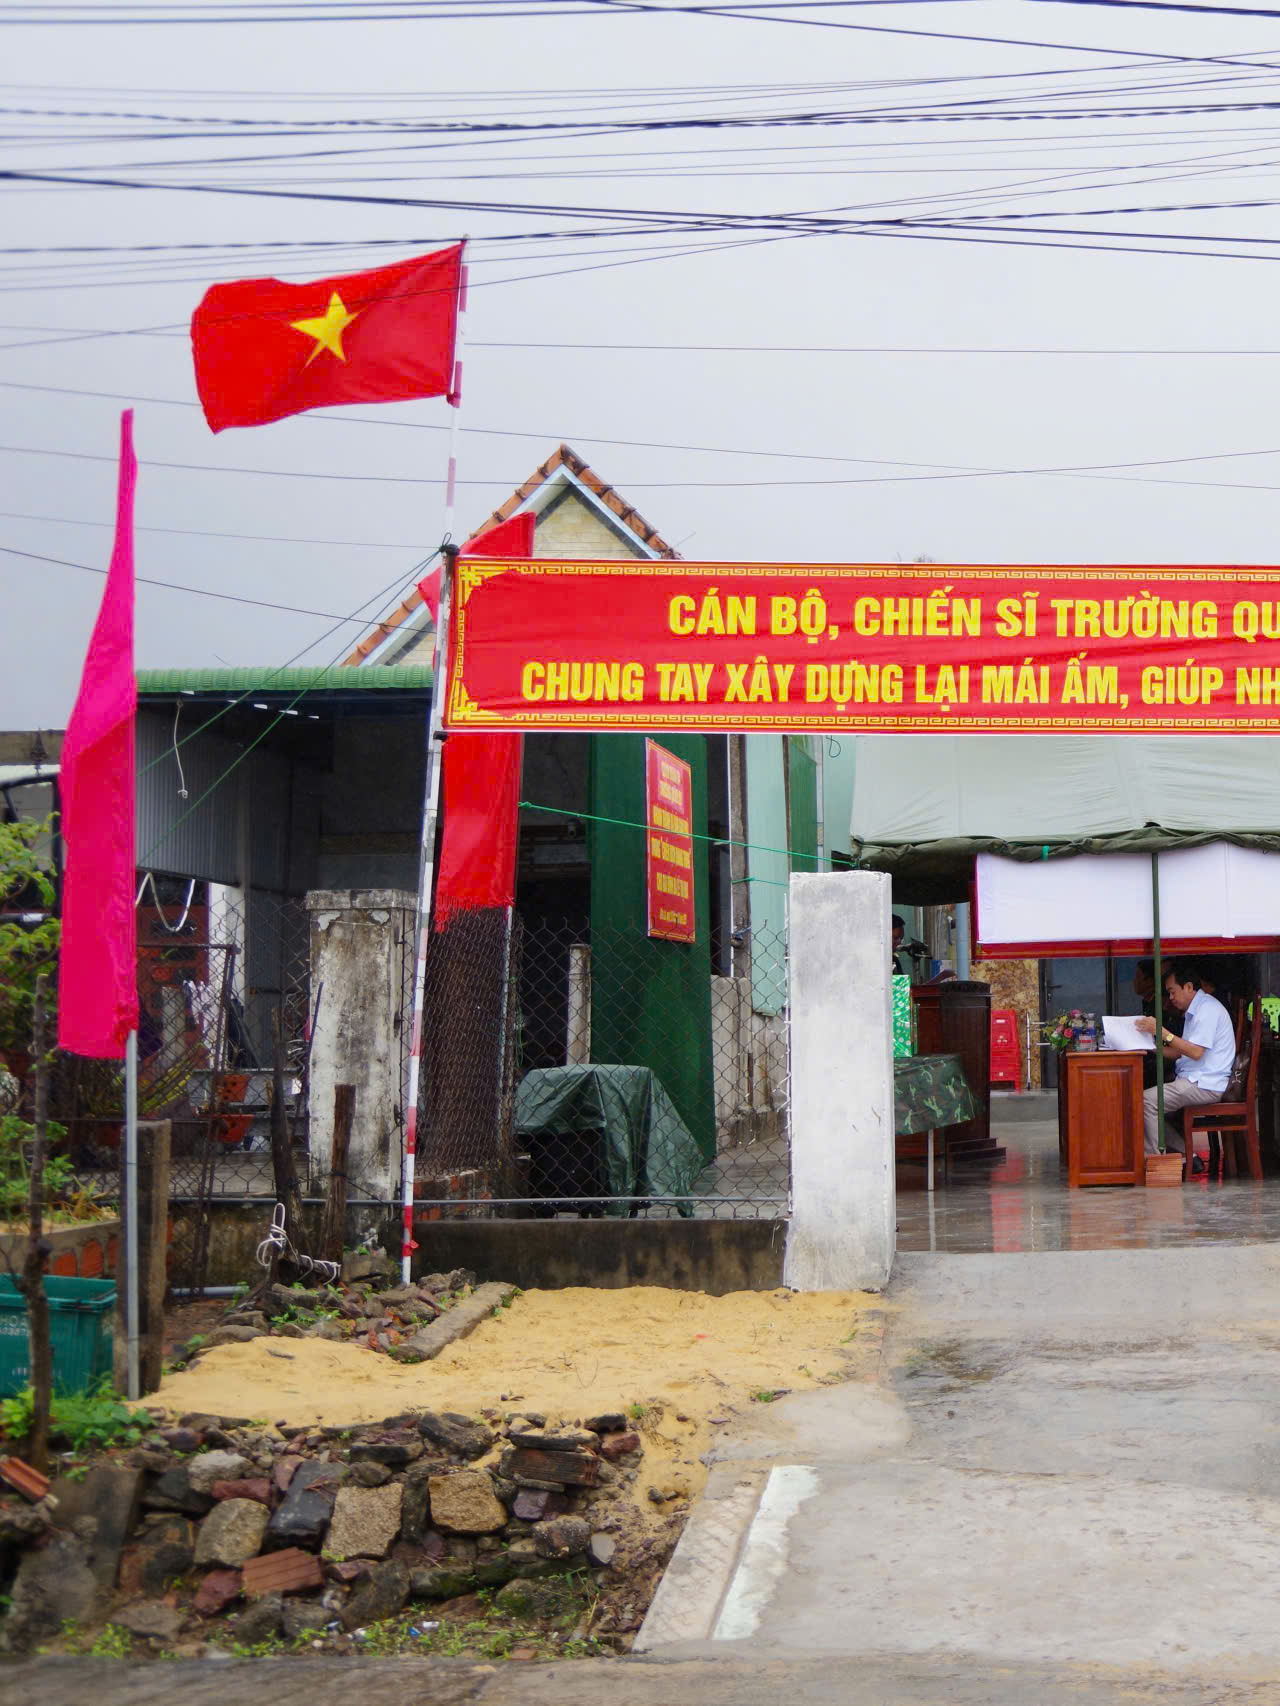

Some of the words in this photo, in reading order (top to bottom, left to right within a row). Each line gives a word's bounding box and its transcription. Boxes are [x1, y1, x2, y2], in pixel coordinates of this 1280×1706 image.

[670, 588, 756, 634] CÁN
[772, 589, 838, 643] BỘ,
[855, 586, 981, 636] CHIẾN
[996, 592, 1039, 636] SĨ
[1051, 591, 1217, 638] TRƯỜNG
[523, 662, 644, 701] CHUNG
[656, 664, 714, 701] TAY
[725, 656, 794, 701] XÂY
[806, 661, 903, 711] DỰNG
[916, 665, 969, 711] LẠI
[982, 658, 1049, 703] MÁI
[1061, 653, 1128, 709] ẤM,
[1142, 659, 1223, 704] GIÚP
